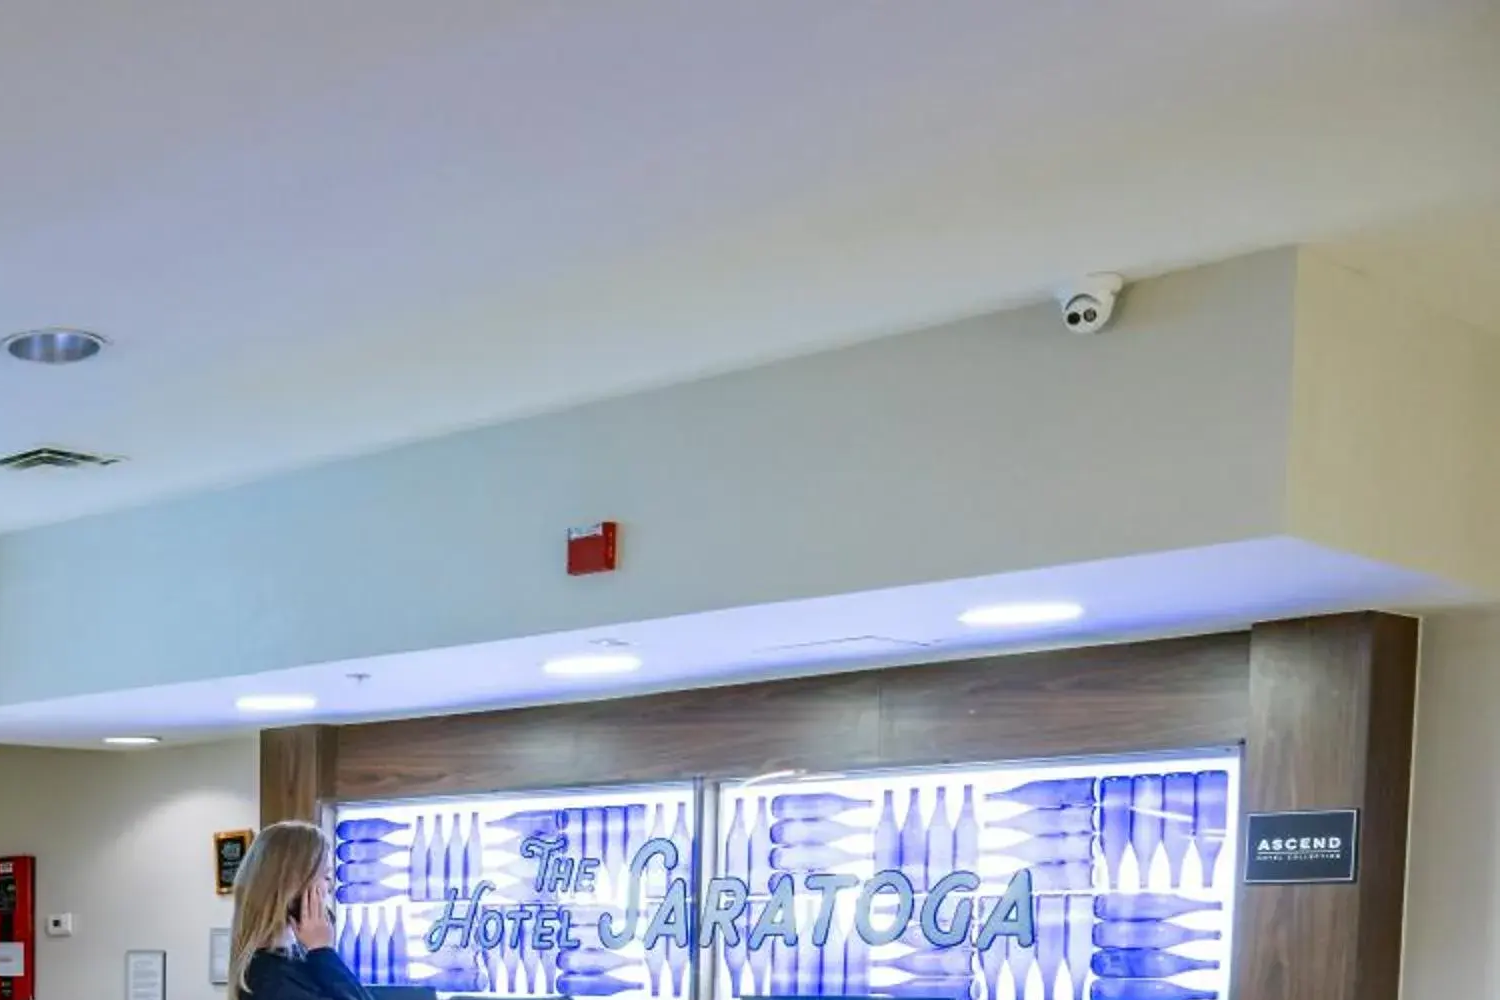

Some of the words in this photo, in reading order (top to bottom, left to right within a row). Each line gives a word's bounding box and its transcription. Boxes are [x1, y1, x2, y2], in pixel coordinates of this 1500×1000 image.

[520, 836, 600, 892] THE
[1257, 837, 1342, 851] ASCEND
[424, 879, 581, 953] HOTEL
[598, 837, 1036, 952] SARATOGA
